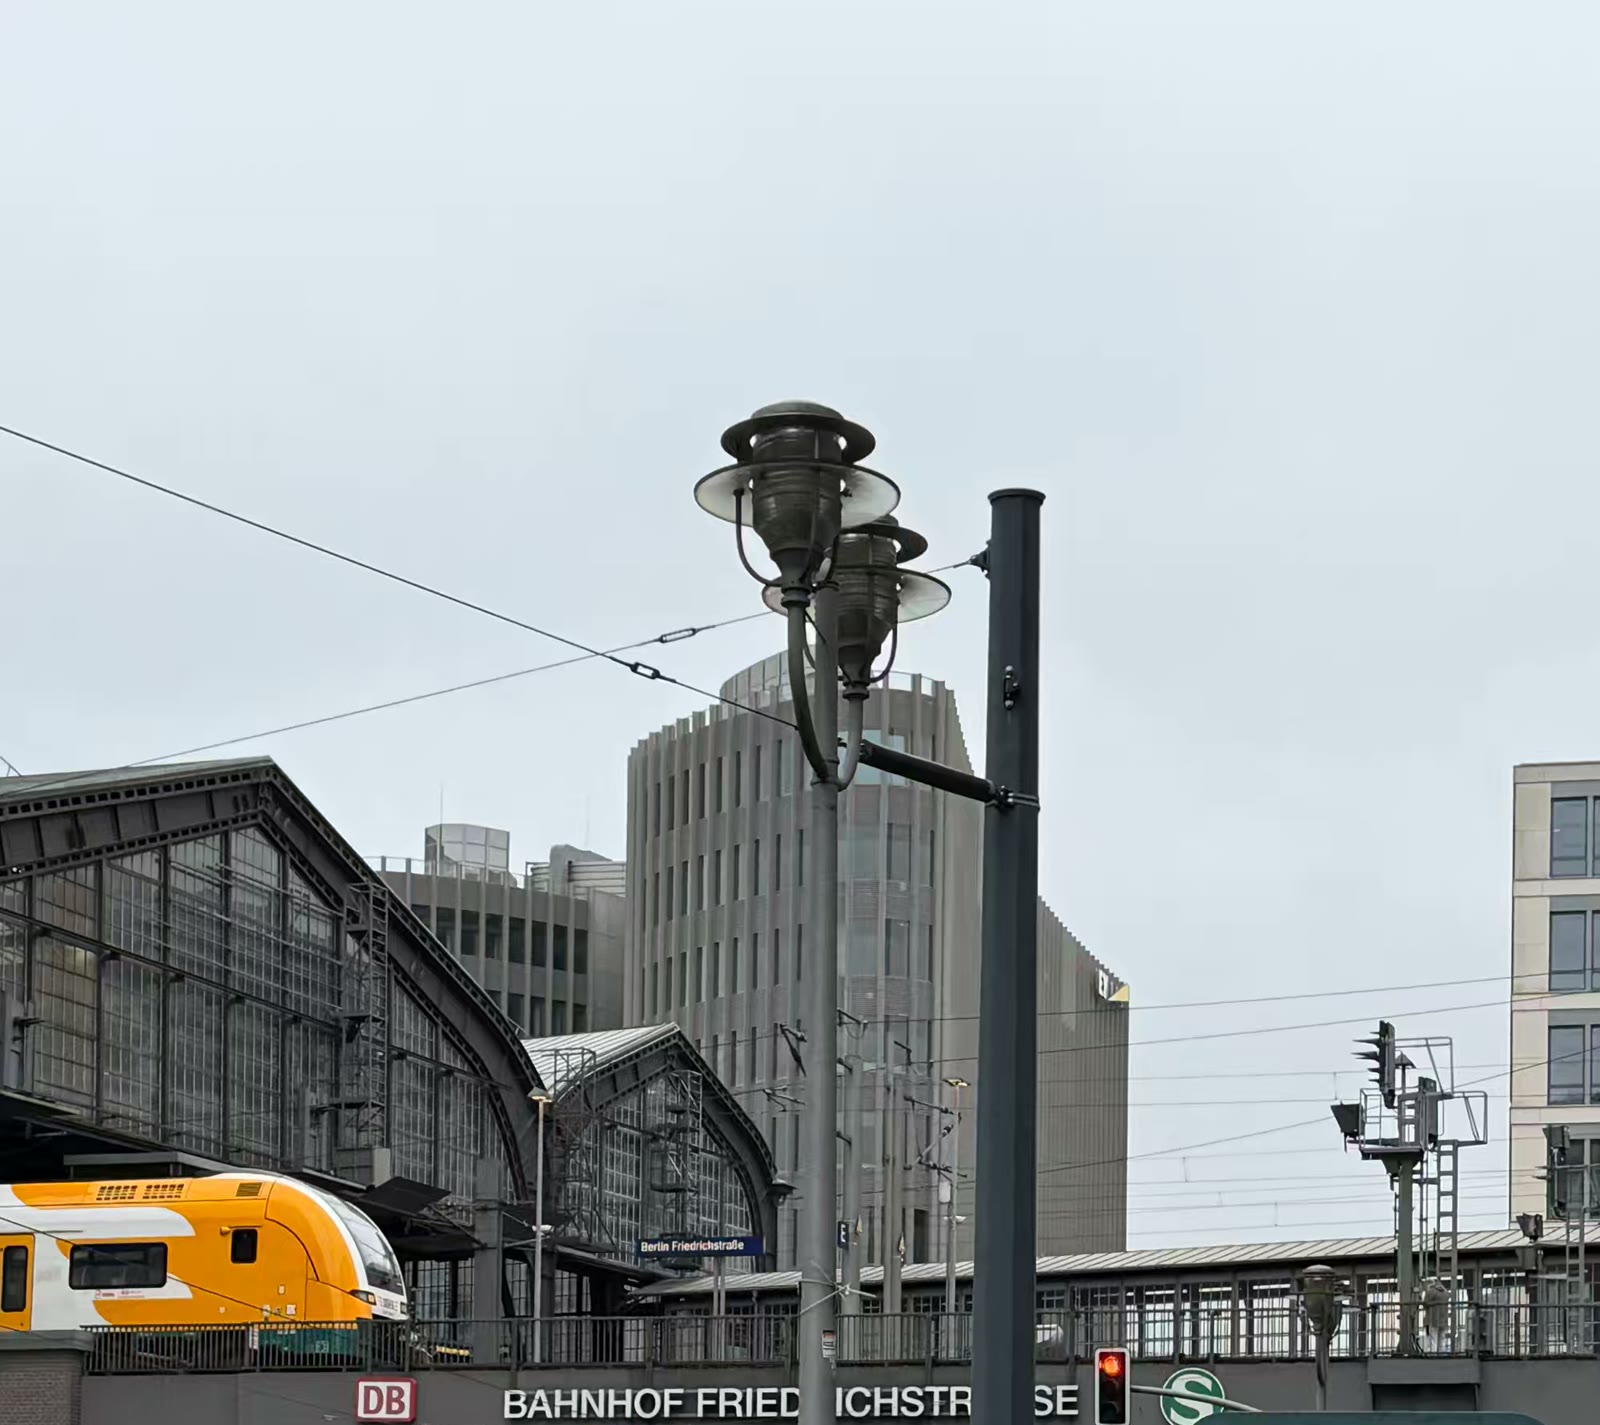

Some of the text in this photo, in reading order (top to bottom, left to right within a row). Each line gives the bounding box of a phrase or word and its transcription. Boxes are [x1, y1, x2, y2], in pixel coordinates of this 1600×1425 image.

[641, 1239, 745, 1252] Berlin Friedrichstraße
[362, 1385, 406, 1415] DB
[504, 1384, 1080, 1419] BAHNHOF FRIEDICHSTRSE
[1168, 1373, 1214, 1425] S
